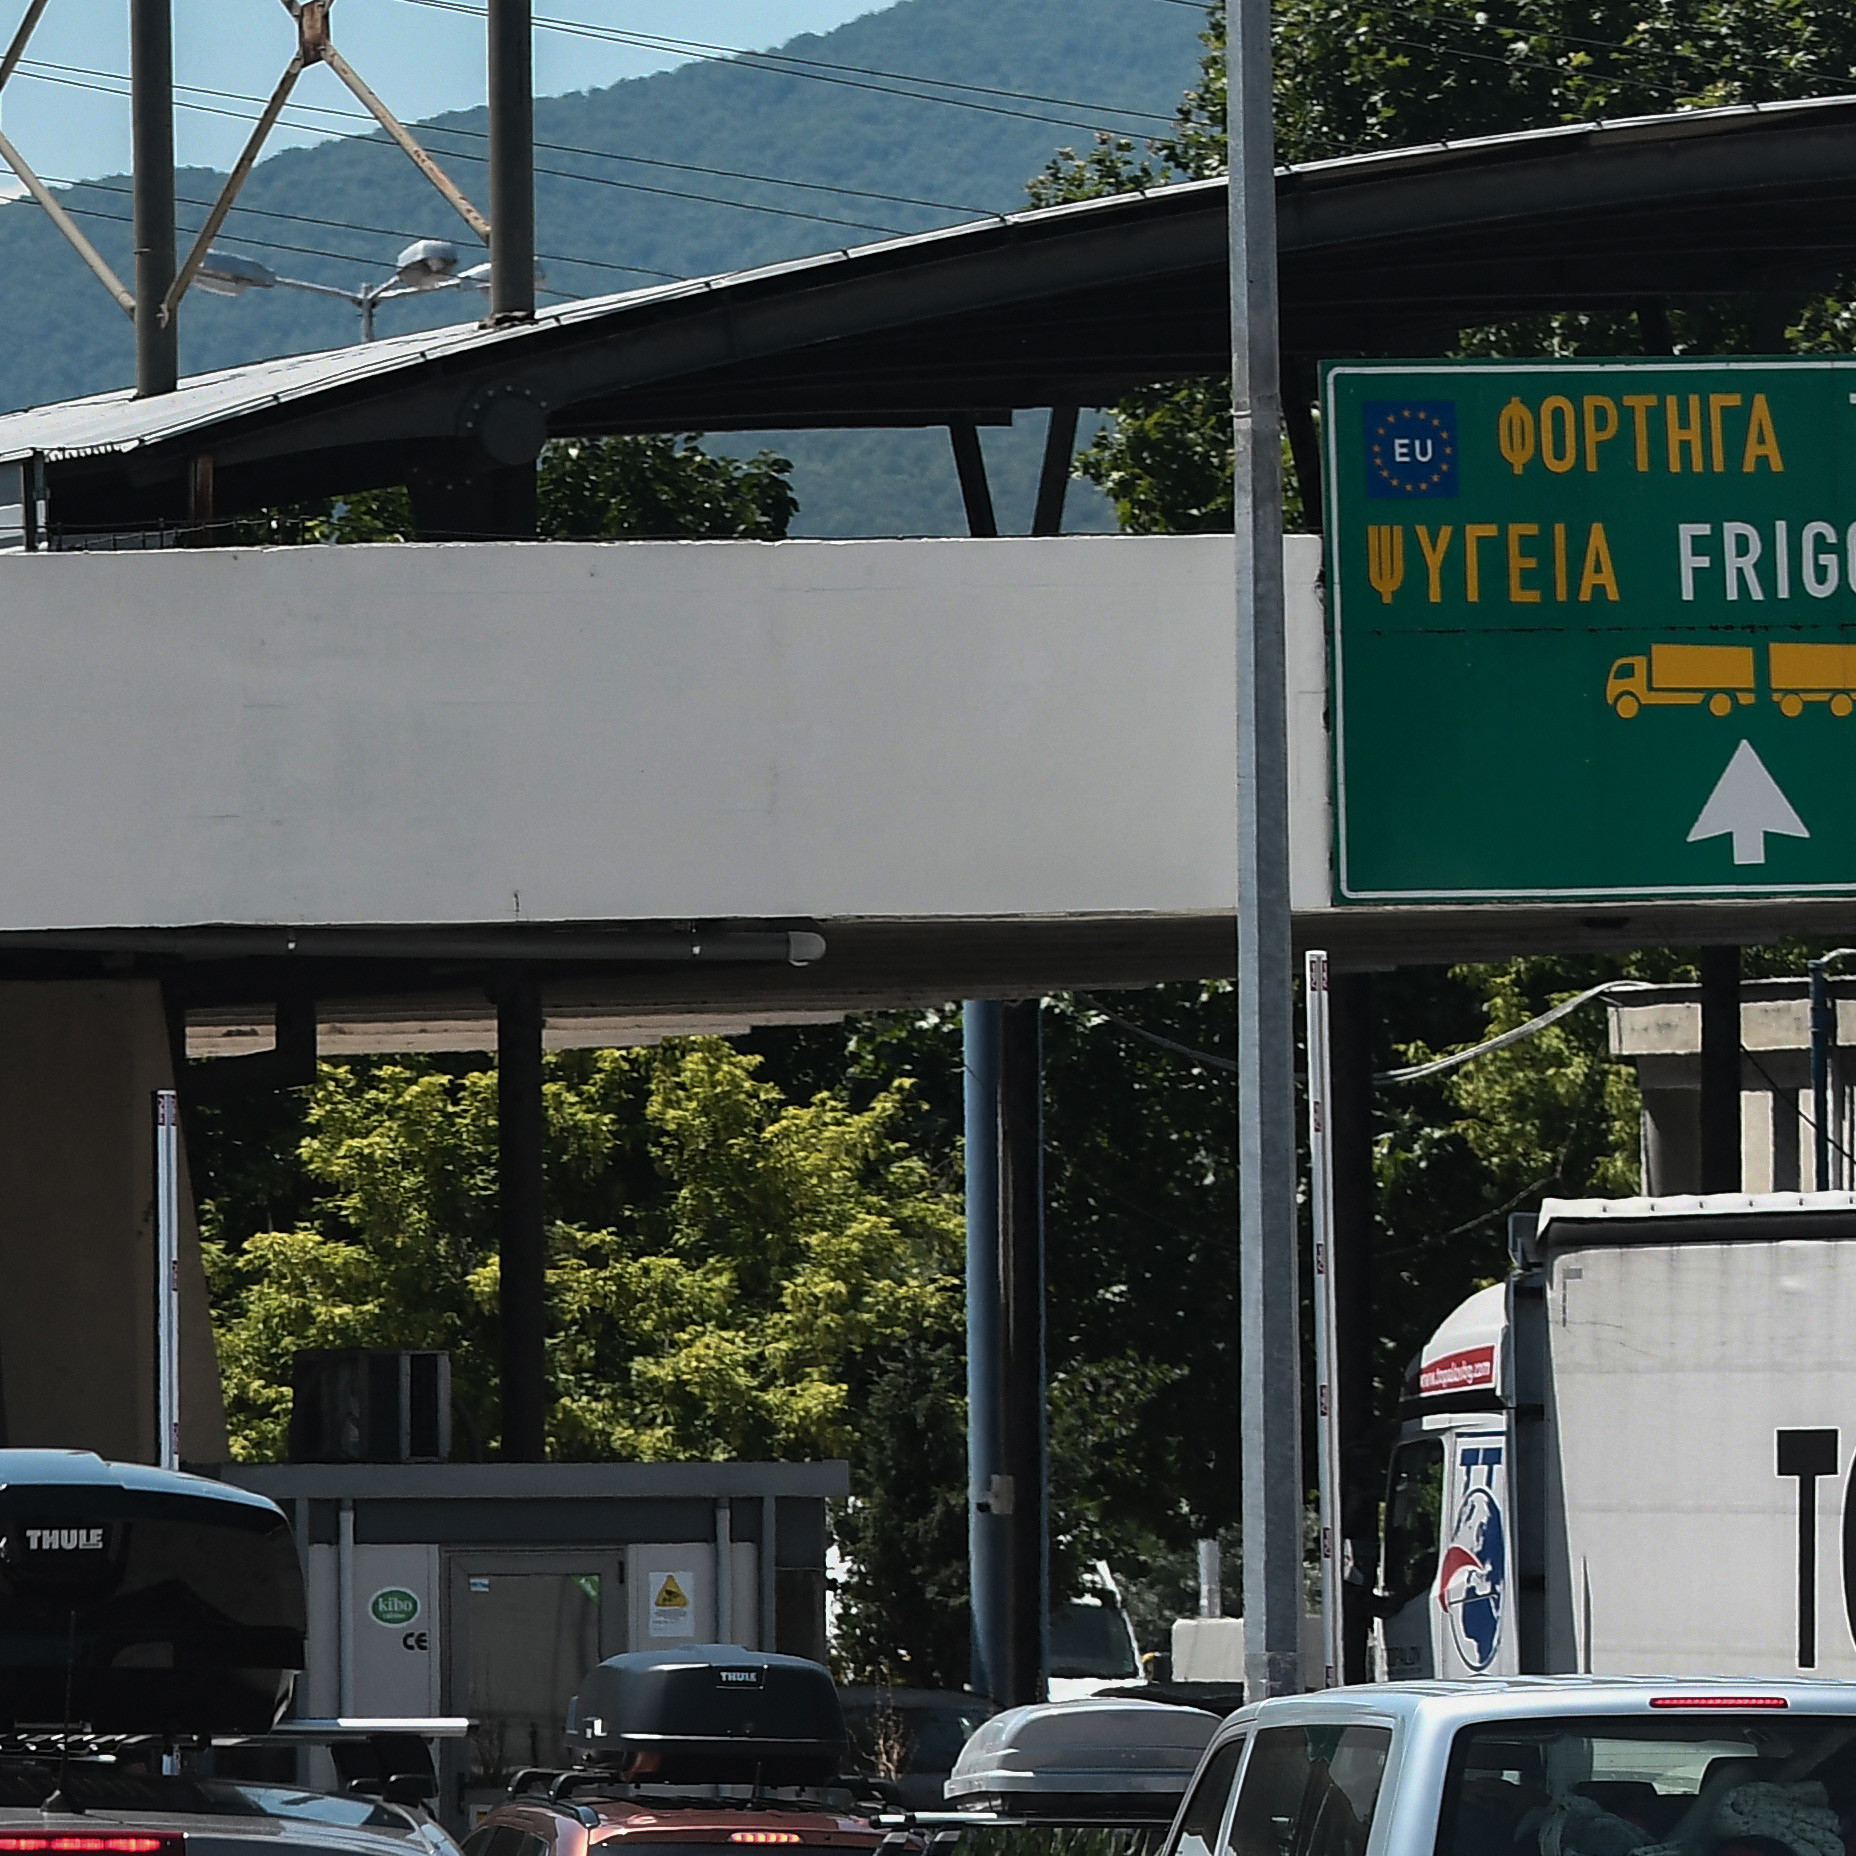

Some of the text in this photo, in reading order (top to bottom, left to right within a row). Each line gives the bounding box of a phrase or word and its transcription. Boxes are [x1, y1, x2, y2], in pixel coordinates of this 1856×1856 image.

[1393, 439, 1433, 462] EU
[1498, 393, 1784, 474] ΦΟΡΤΗΓΑ
[1366, 522, 1620, 604] ΨΥΓΕΙΑ
[1677, 520, 1856, 601] FRIG
[26, 1528, 103, 1551] THULE
[1776, 1427, 1856, 1670] T
[720, 1671, 757, 1683] THULE
